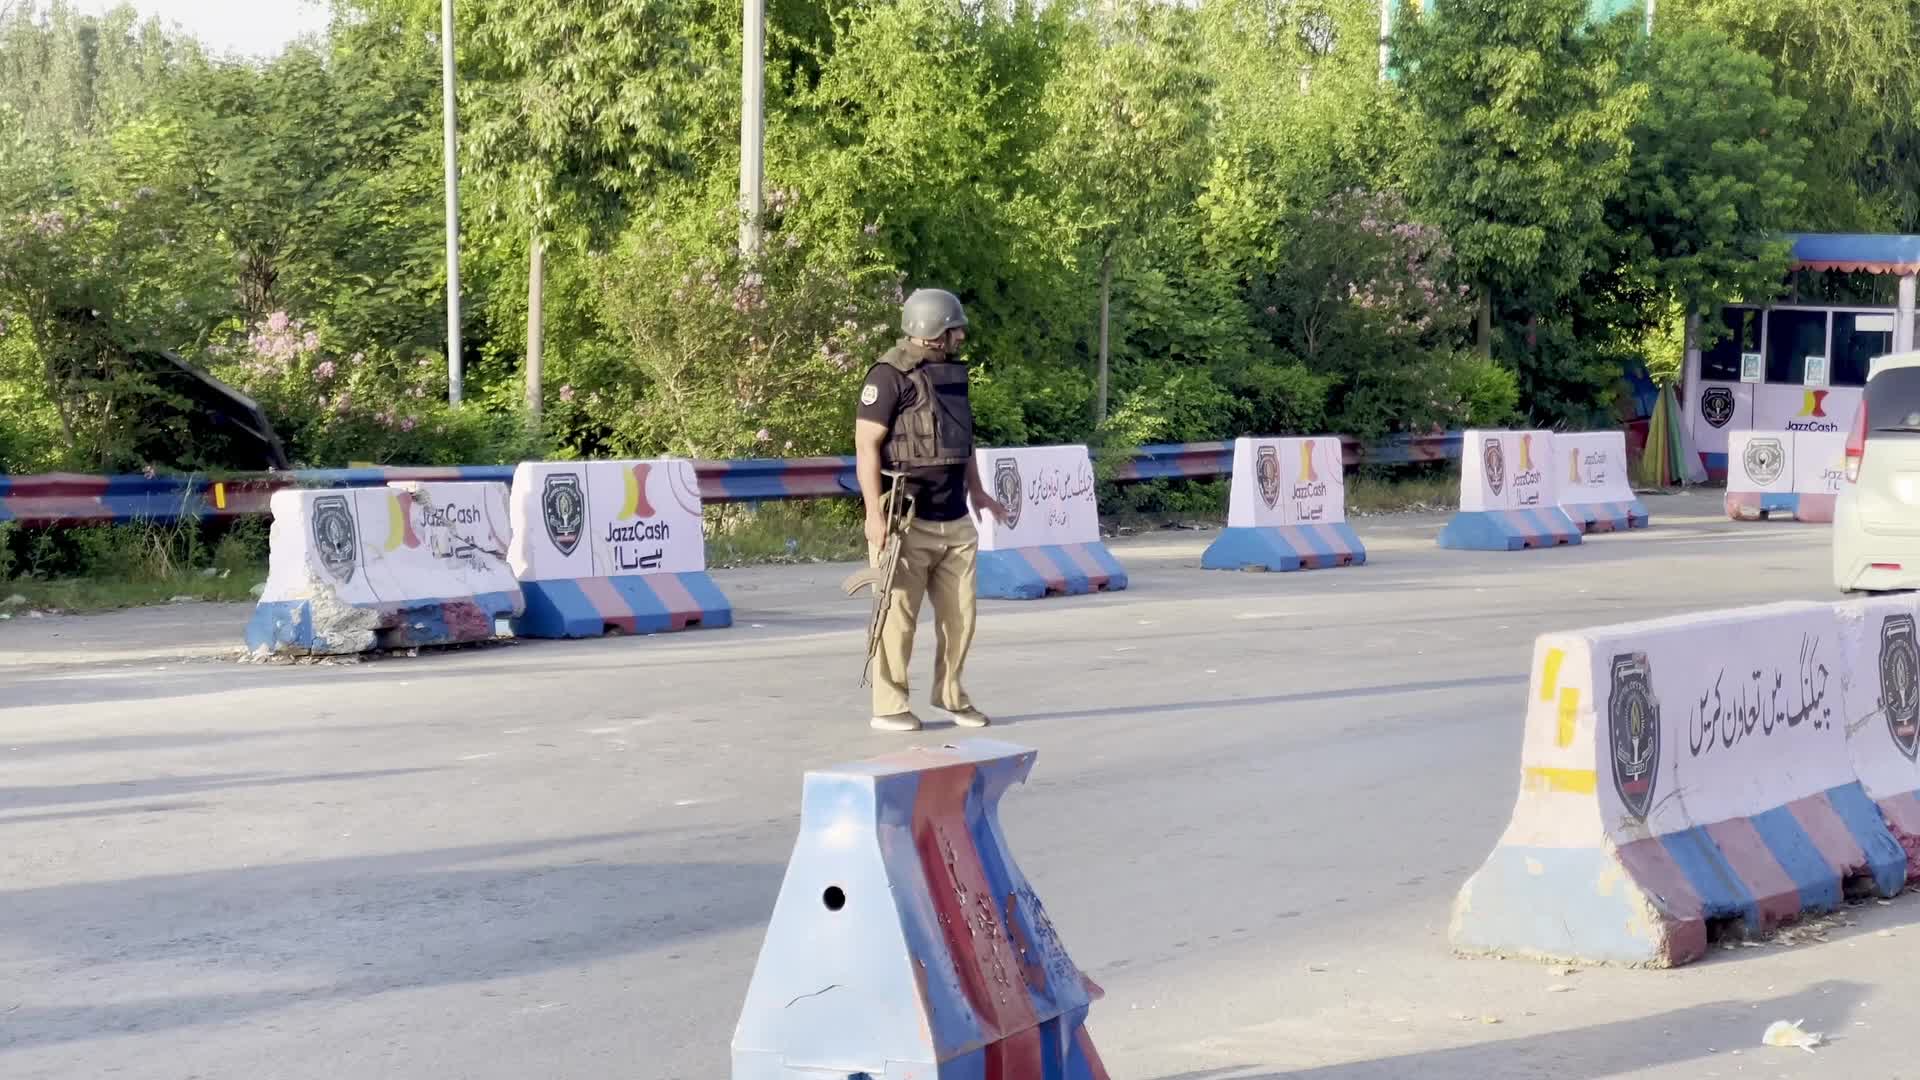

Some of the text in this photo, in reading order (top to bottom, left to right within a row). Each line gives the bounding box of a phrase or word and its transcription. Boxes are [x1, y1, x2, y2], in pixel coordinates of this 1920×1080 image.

[1785, 420, 1838, 433] JazzCash
[1292, 482, 1327, 505] JazzCash
[605, 519, 670, 542] JazzCash
[1689, 631, 1831, 757] چیکنگ میں تعاون کریں
